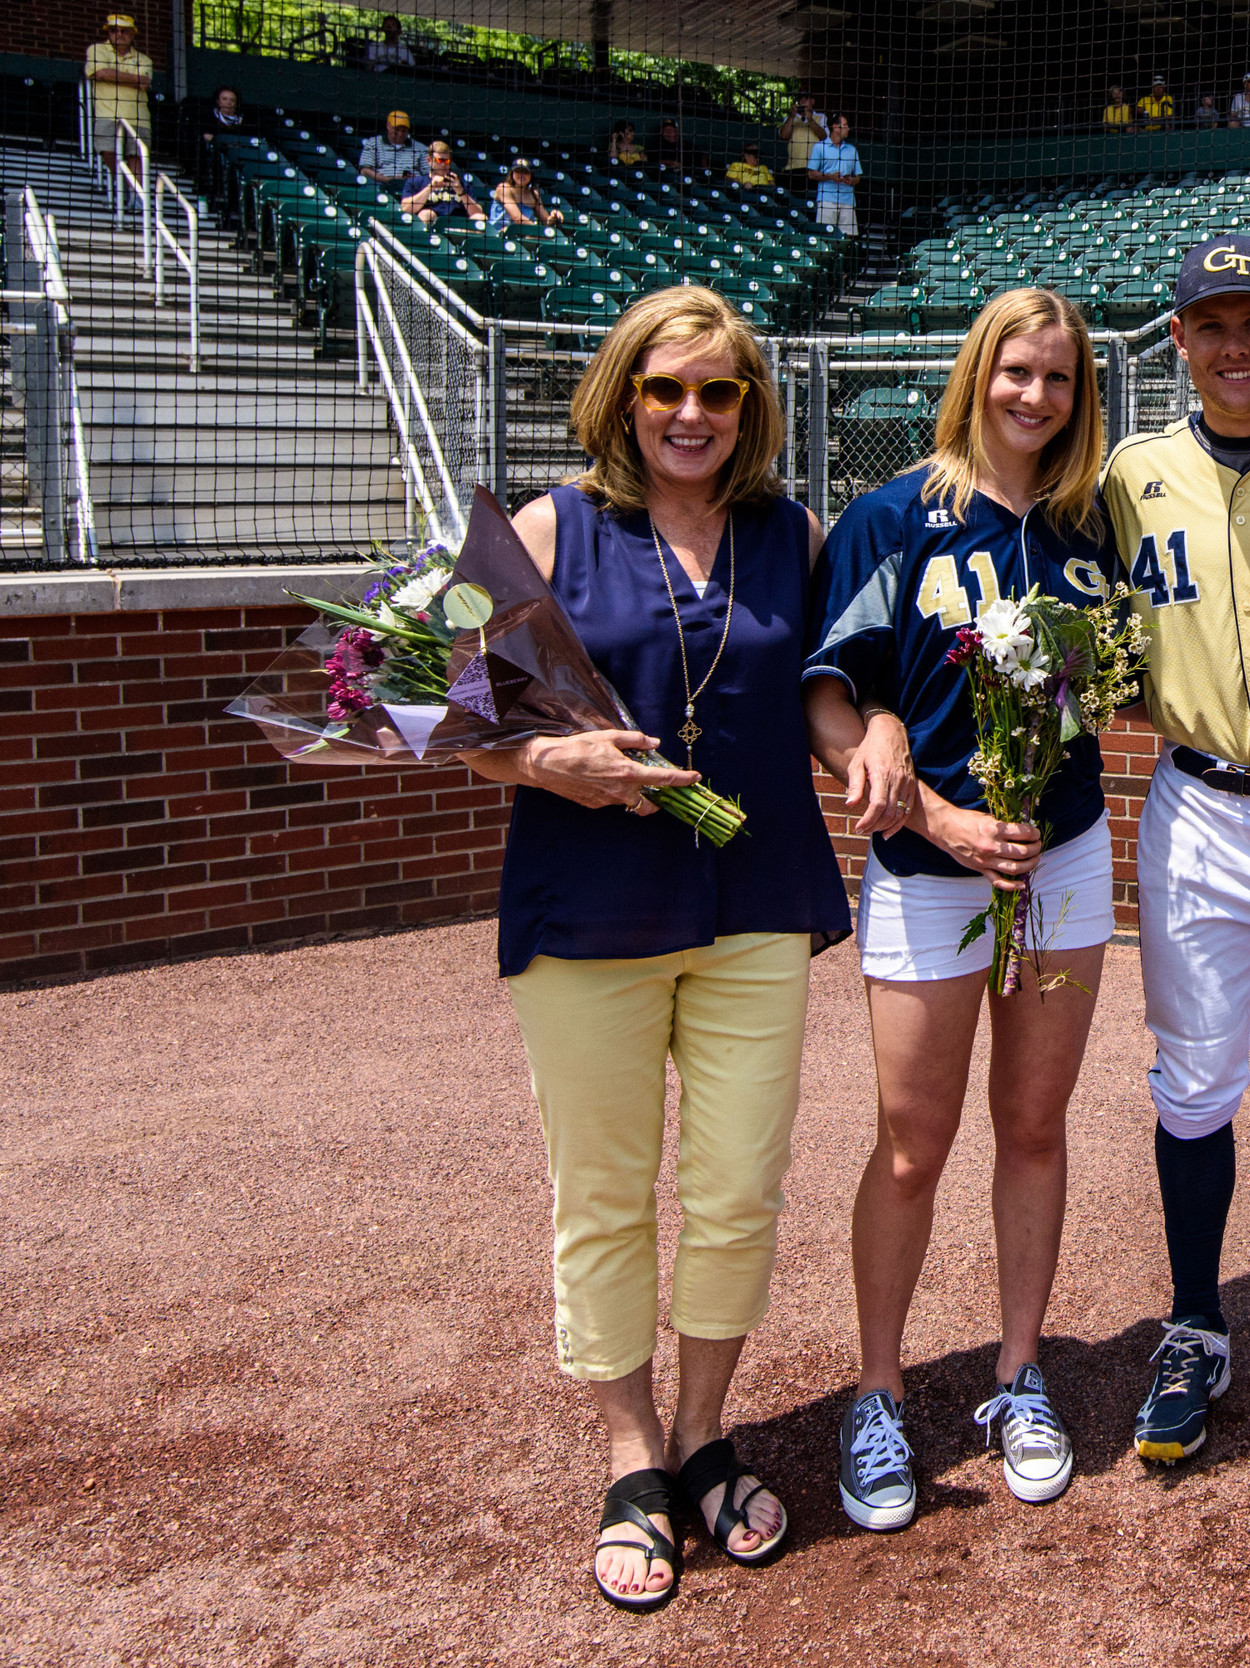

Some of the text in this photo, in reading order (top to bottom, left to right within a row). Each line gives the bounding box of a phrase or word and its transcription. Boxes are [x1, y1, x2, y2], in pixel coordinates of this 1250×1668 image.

[924, 520, 958, 529] RUSSELL
[916, 551, 1001, 630] 41
[1129, 528, 1200, 608] 41
